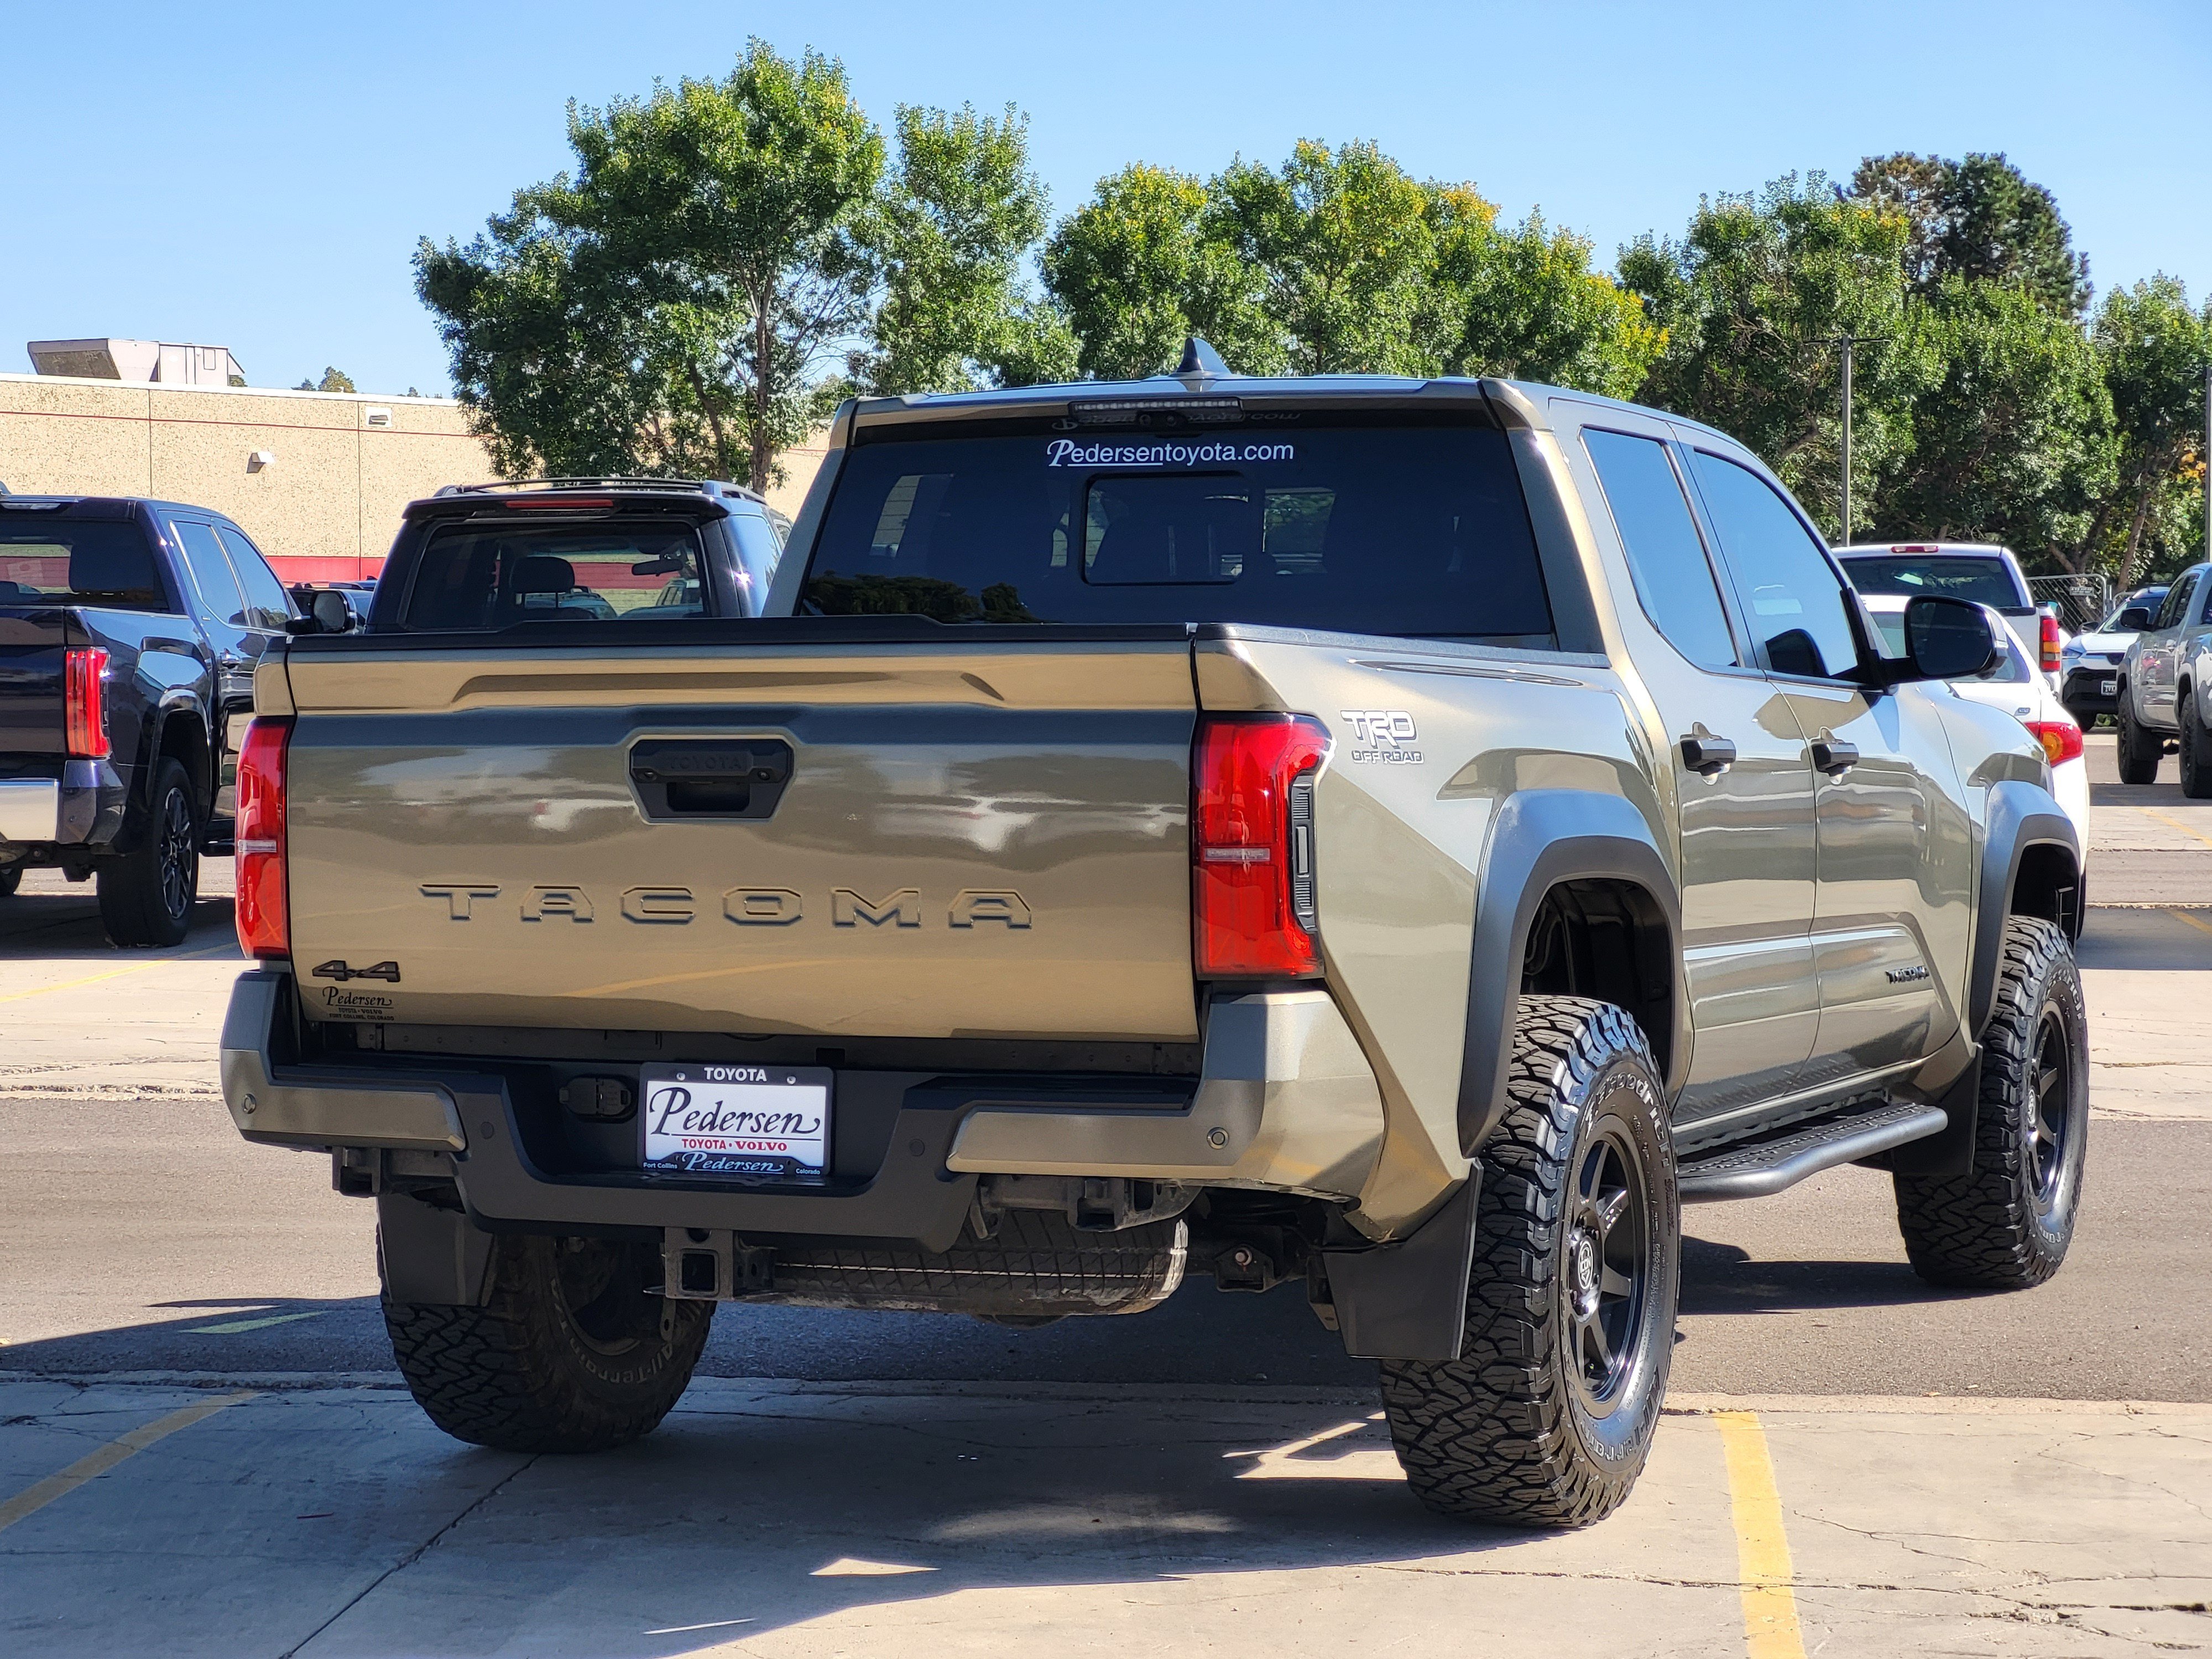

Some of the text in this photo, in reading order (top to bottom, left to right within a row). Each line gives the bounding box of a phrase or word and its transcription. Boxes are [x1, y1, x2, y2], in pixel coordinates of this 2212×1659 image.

[1047, 439, 1294, 467] Pedersentoyota.com
[1340, 710, 1417, 749] TRD
[1352, 750, 1425, 764] OFF ROAD
[418, 884, 1032, 930] TACOMA
[322, 986, 392, 1006] Pedersen
[703, 1067, 767, 1082] TOYOTA
[649, 1087, 821, 1136] Pedersen
[681, 1138, 787, 1151] TOYOTA VOLVO
[681, 1151, 784, 1172] Pedersen
